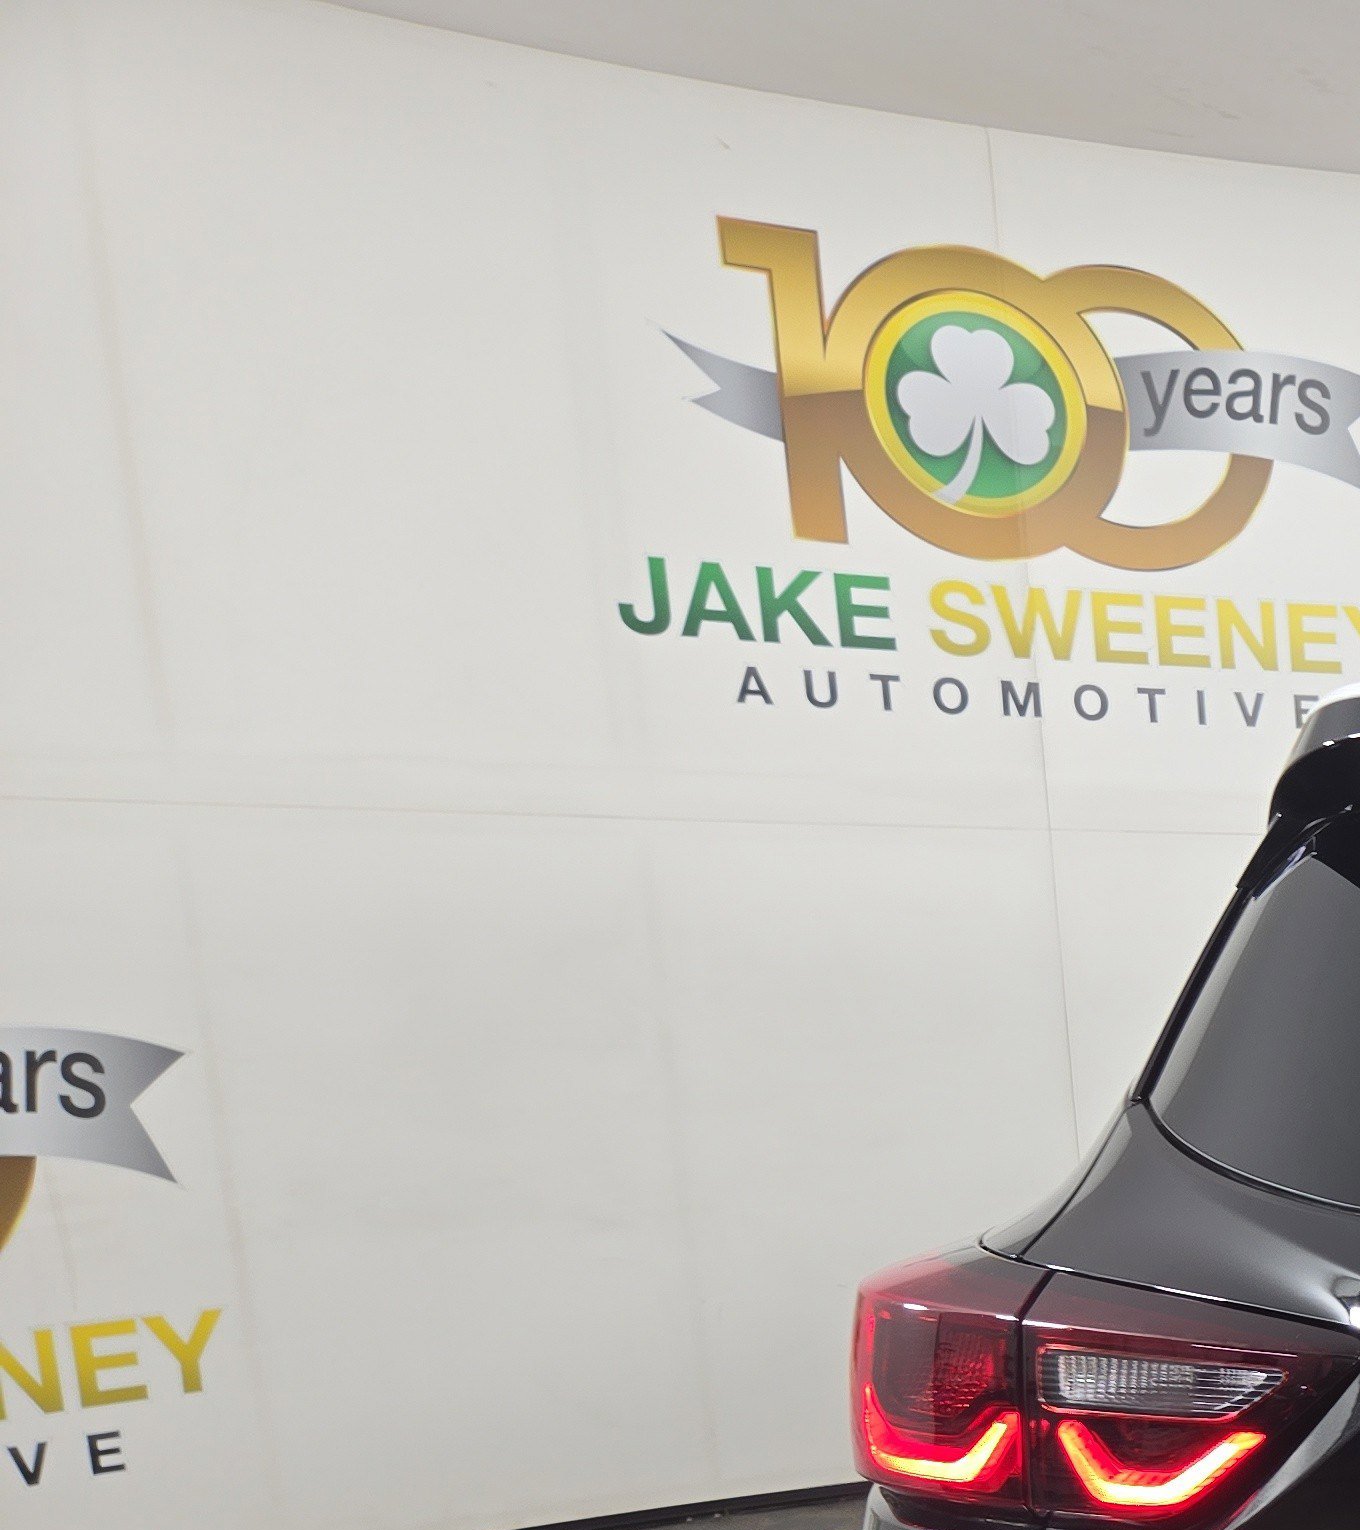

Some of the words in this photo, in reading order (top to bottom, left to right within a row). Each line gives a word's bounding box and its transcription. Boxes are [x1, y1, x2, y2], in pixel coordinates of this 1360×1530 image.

[716, 214, 1276, 572] 100
[1140, 366, 1332, 437] years
[617, 556, 898, 652] JAKE
[736, 665, 1320, 730] AUTOMOTIVE
